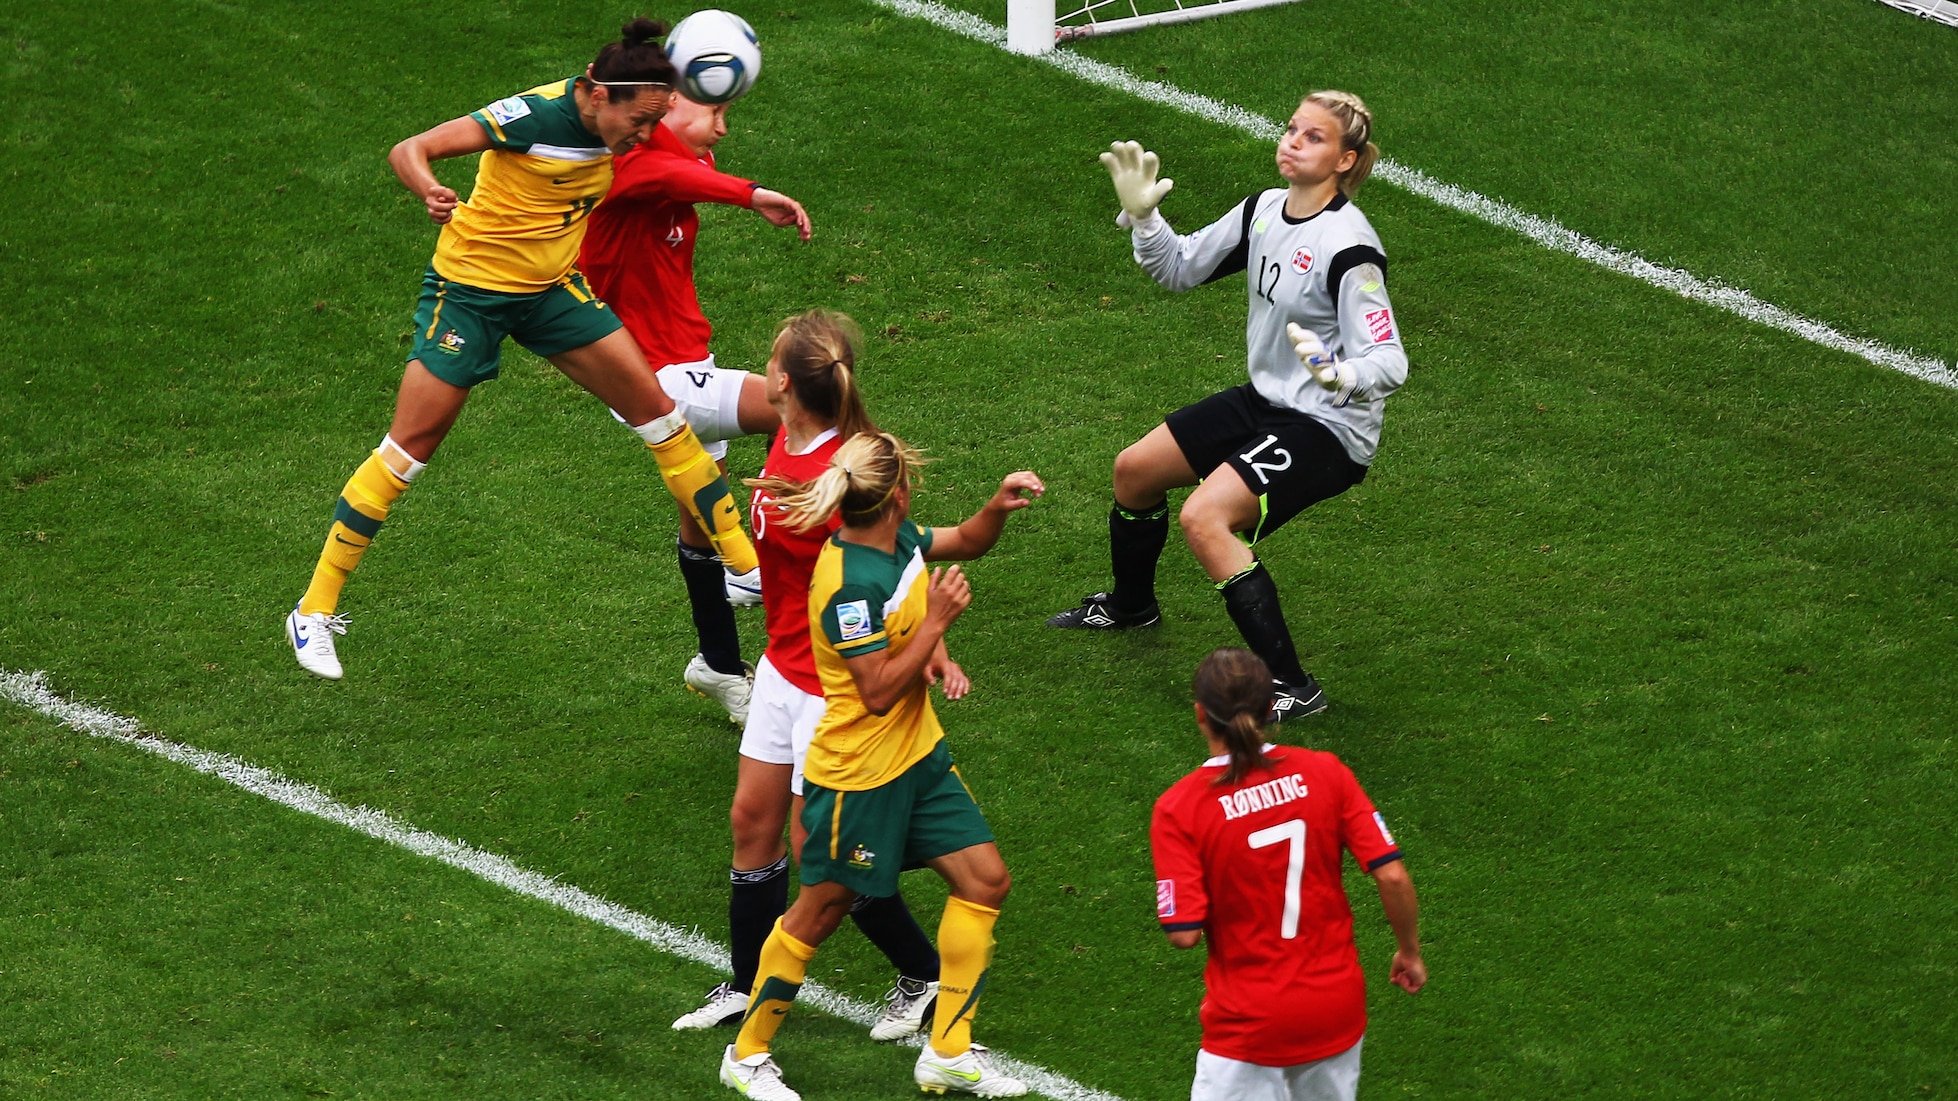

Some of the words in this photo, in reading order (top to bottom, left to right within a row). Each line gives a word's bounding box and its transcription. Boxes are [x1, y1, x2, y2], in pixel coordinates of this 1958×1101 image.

[665, 214, 684, 248] 4
[1257, 255, 1281, 306] 12
[685, 371, 714, 388] 4
[1239, 434, 1292, 485] 12
[1217, 773, 1309, 820] RØNNING
[1248, 818, 1307, 939] 7
